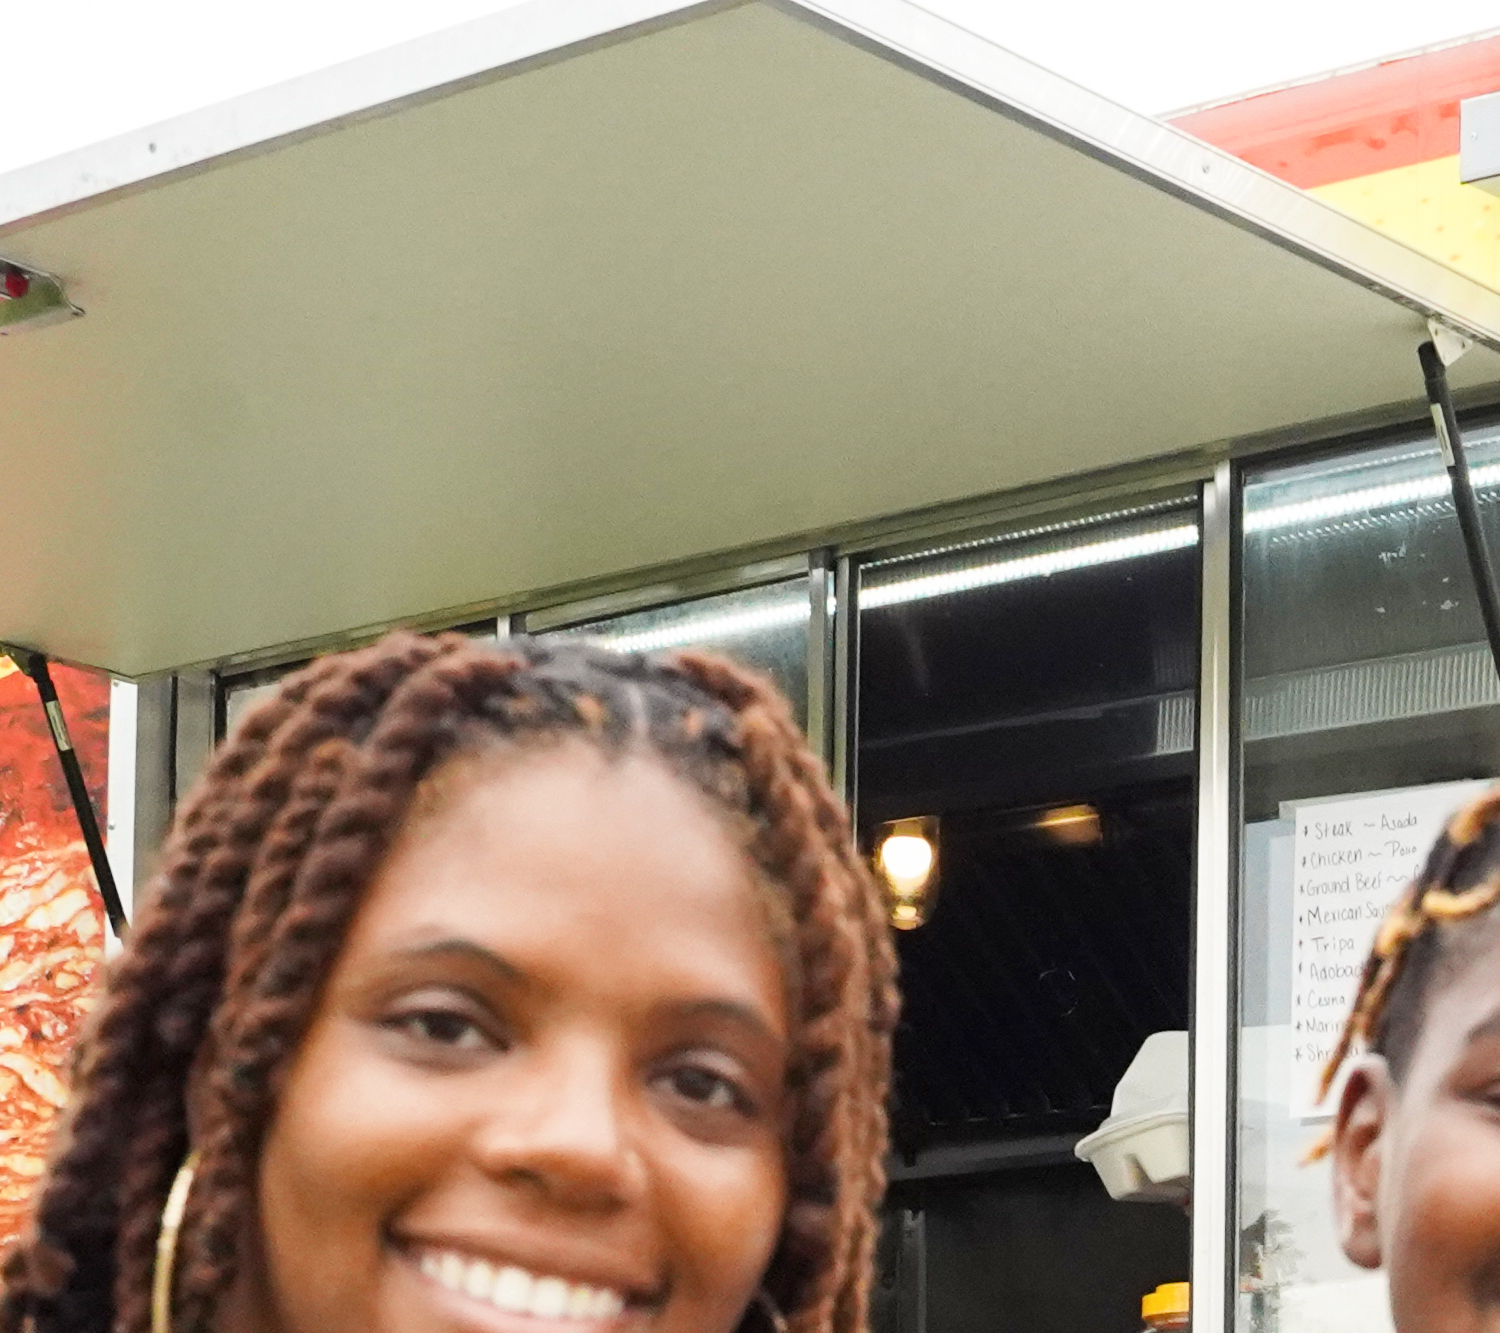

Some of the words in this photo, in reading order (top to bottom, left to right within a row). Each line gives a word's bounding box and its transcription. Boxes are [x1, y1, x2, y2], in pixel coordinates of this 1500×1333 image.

[1314, 821, 1353, 839] Steak
[1310, 849, 1363, 869] Chicken
[1306, 876, 1350, 896] Ground
[1307, 904, 1363, 926] Mexican
[1310, 936, 1355, 955] Tripa
